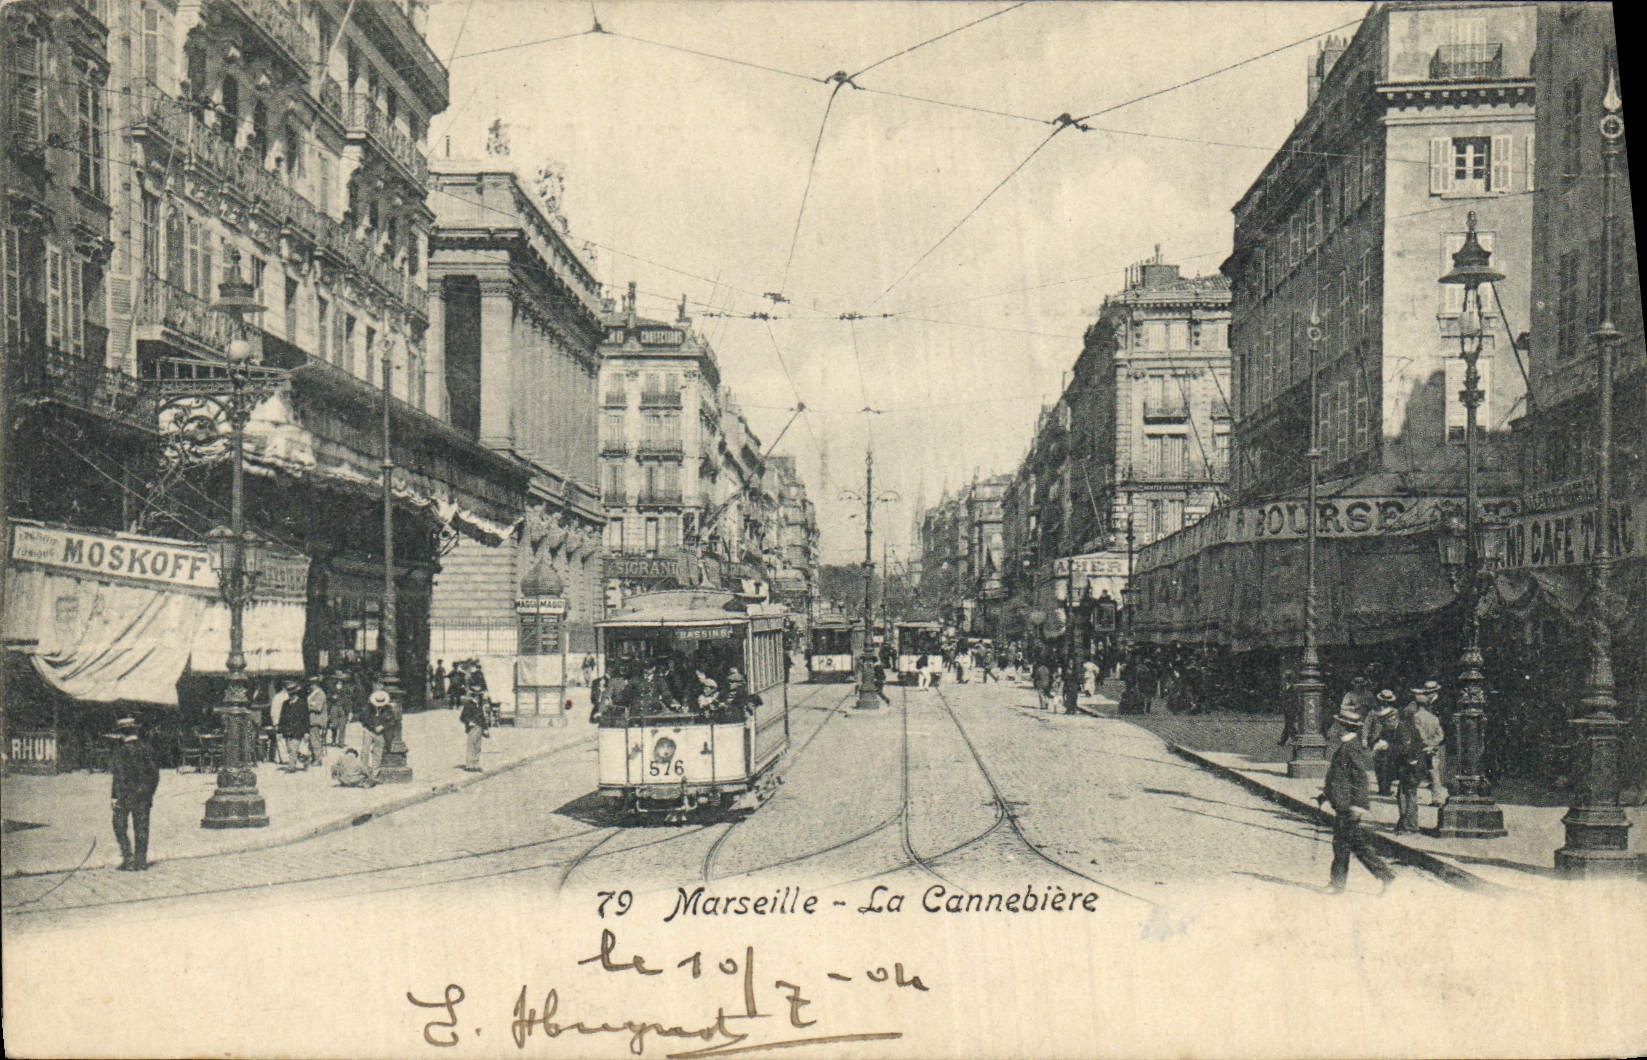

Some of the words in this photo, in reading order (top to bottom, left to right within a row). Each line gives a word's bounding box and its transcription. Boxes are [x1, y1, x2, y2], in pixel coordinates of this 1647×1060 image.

[62, 537, 207, 580] MOSKOFF
[649, 759, 684, 776] 576
[577, 929, 663, 974] le
